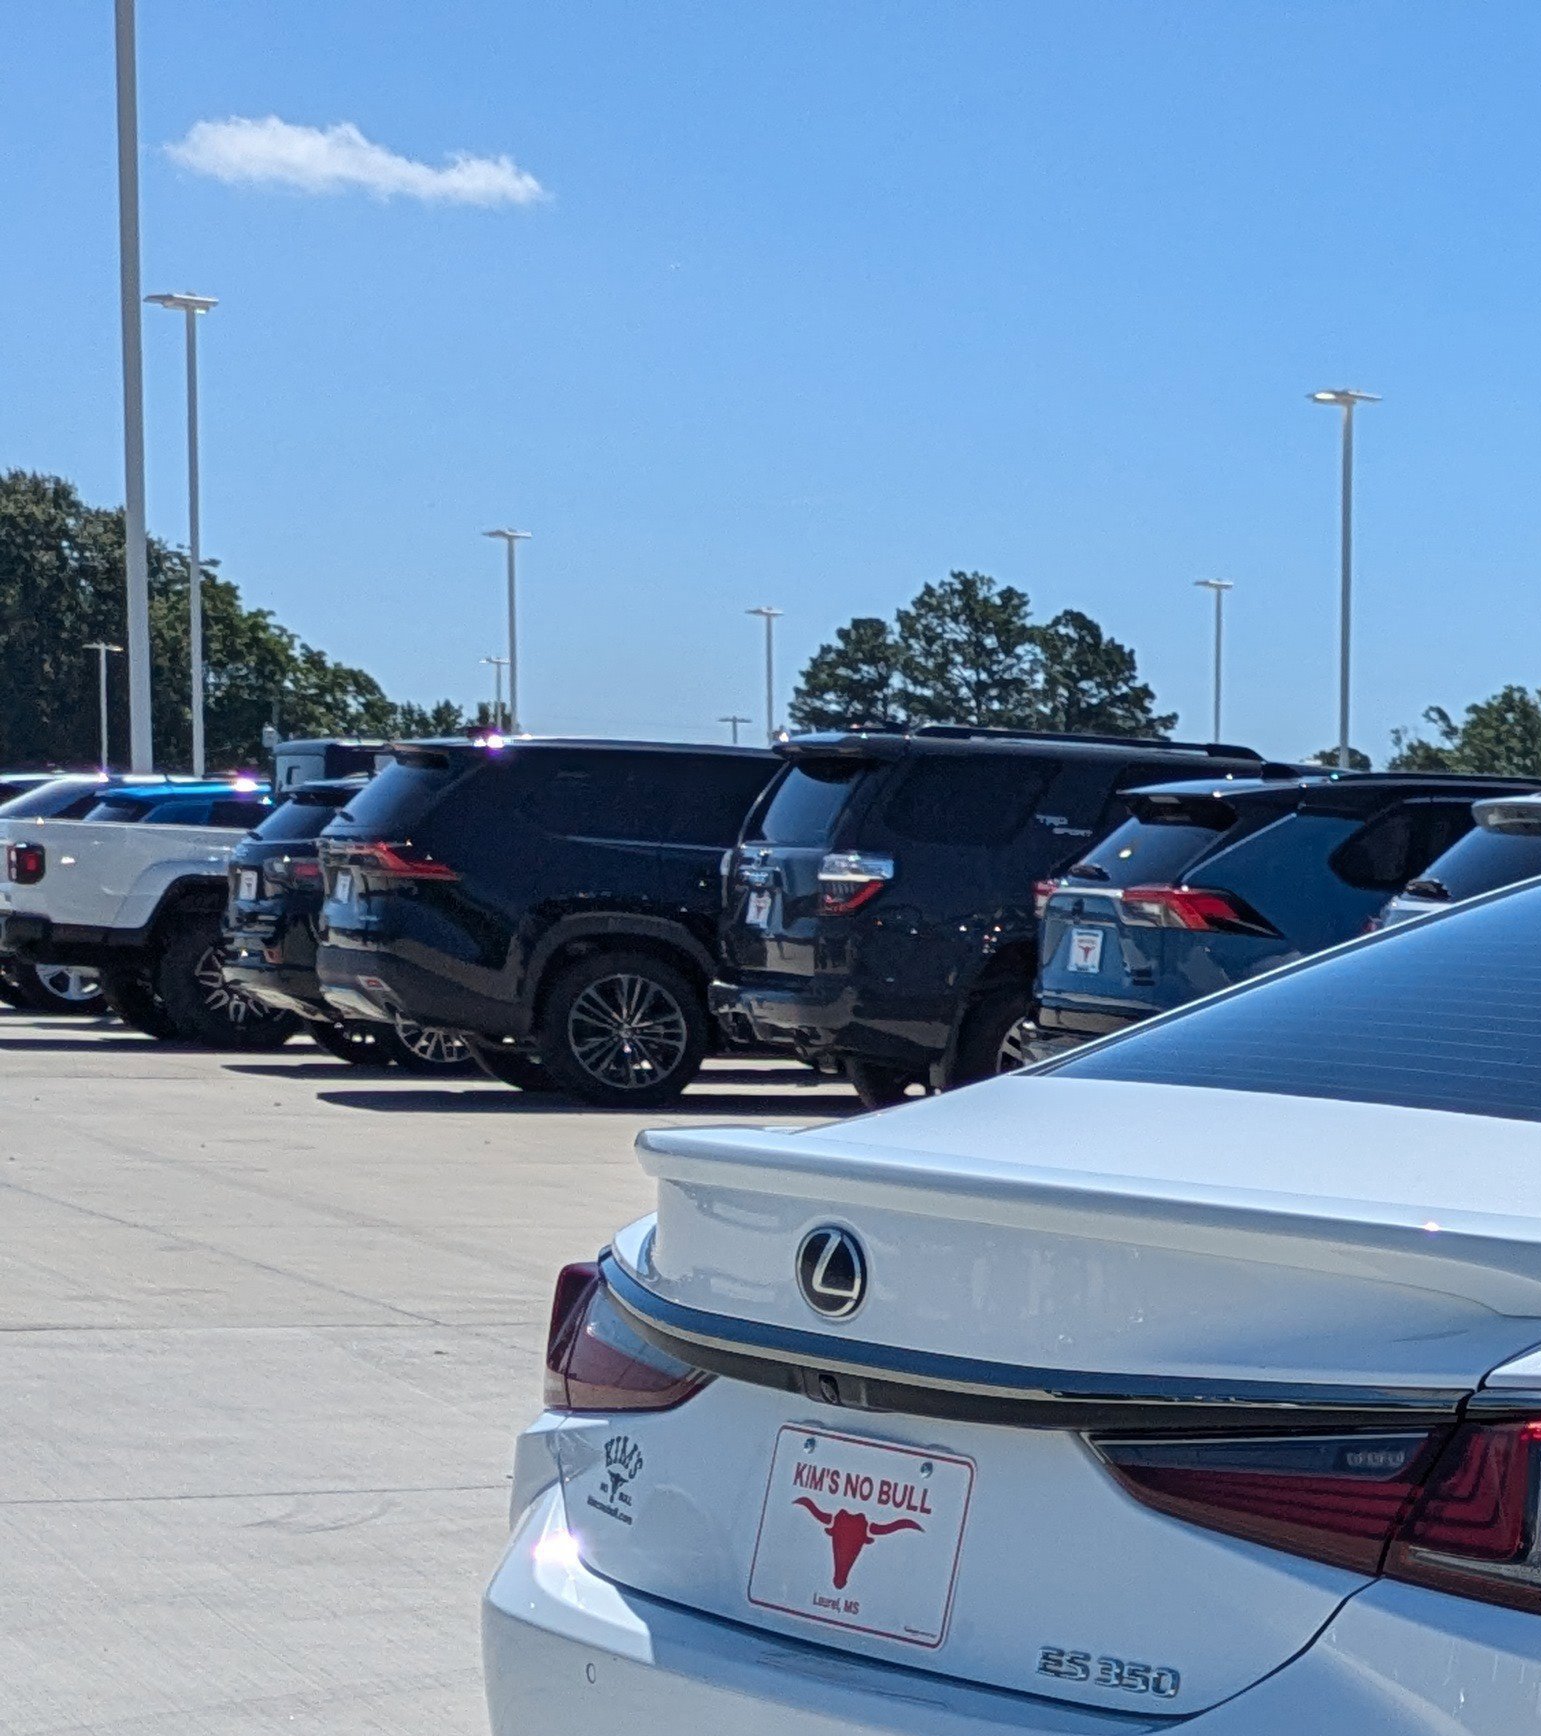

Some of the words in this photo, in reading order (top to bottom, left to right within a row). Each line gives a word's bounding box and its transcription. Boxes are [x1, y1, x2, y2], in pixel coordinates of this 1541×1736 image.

[793, 1461, 840, 1495] KIM'S
[843, 1472, 874, 1501] NO
[877, 1479, 932, 1515] BULL
[1036, 1645, 1092, 1682] ES
[1095, 1655, 1181, 1699] 350
